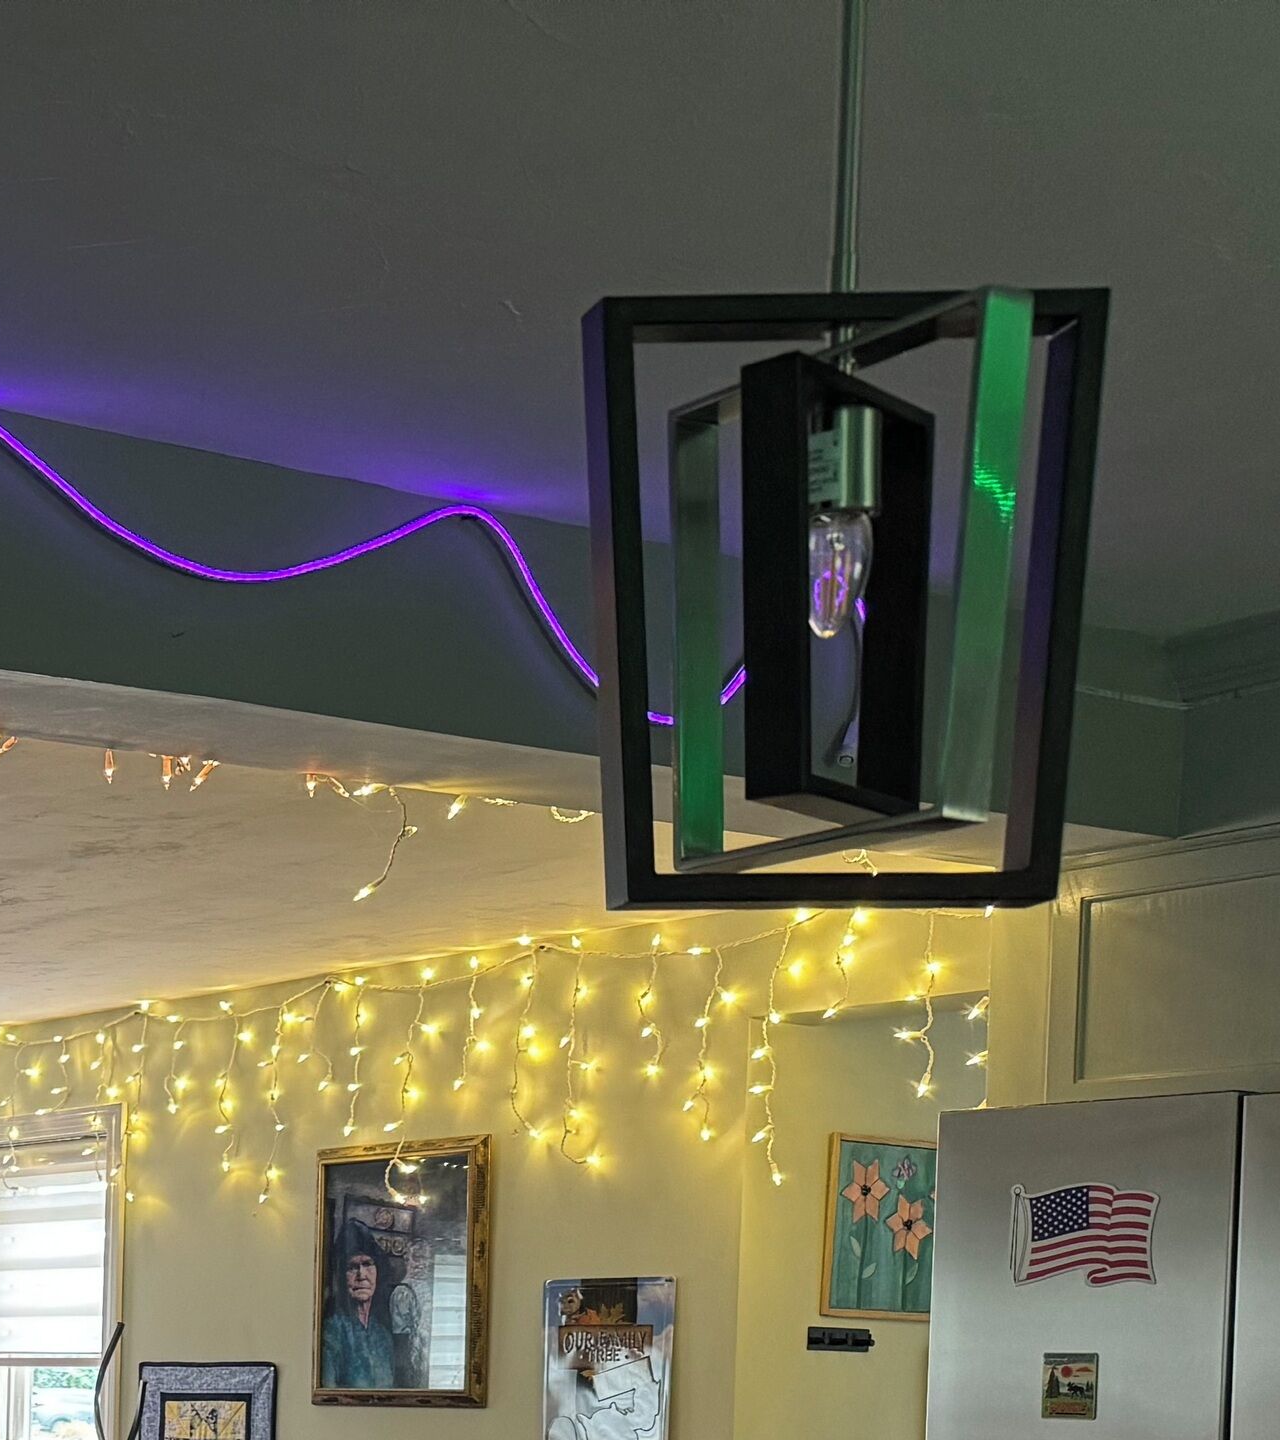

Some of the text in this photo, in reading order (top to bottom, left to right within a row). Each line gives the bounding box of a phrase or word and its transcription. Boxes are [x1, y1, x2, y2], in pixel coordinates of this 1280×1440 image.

[563, 1331, 647, 1354] OUR FAMILY
[587, 1347, 620, 1362] TREE
